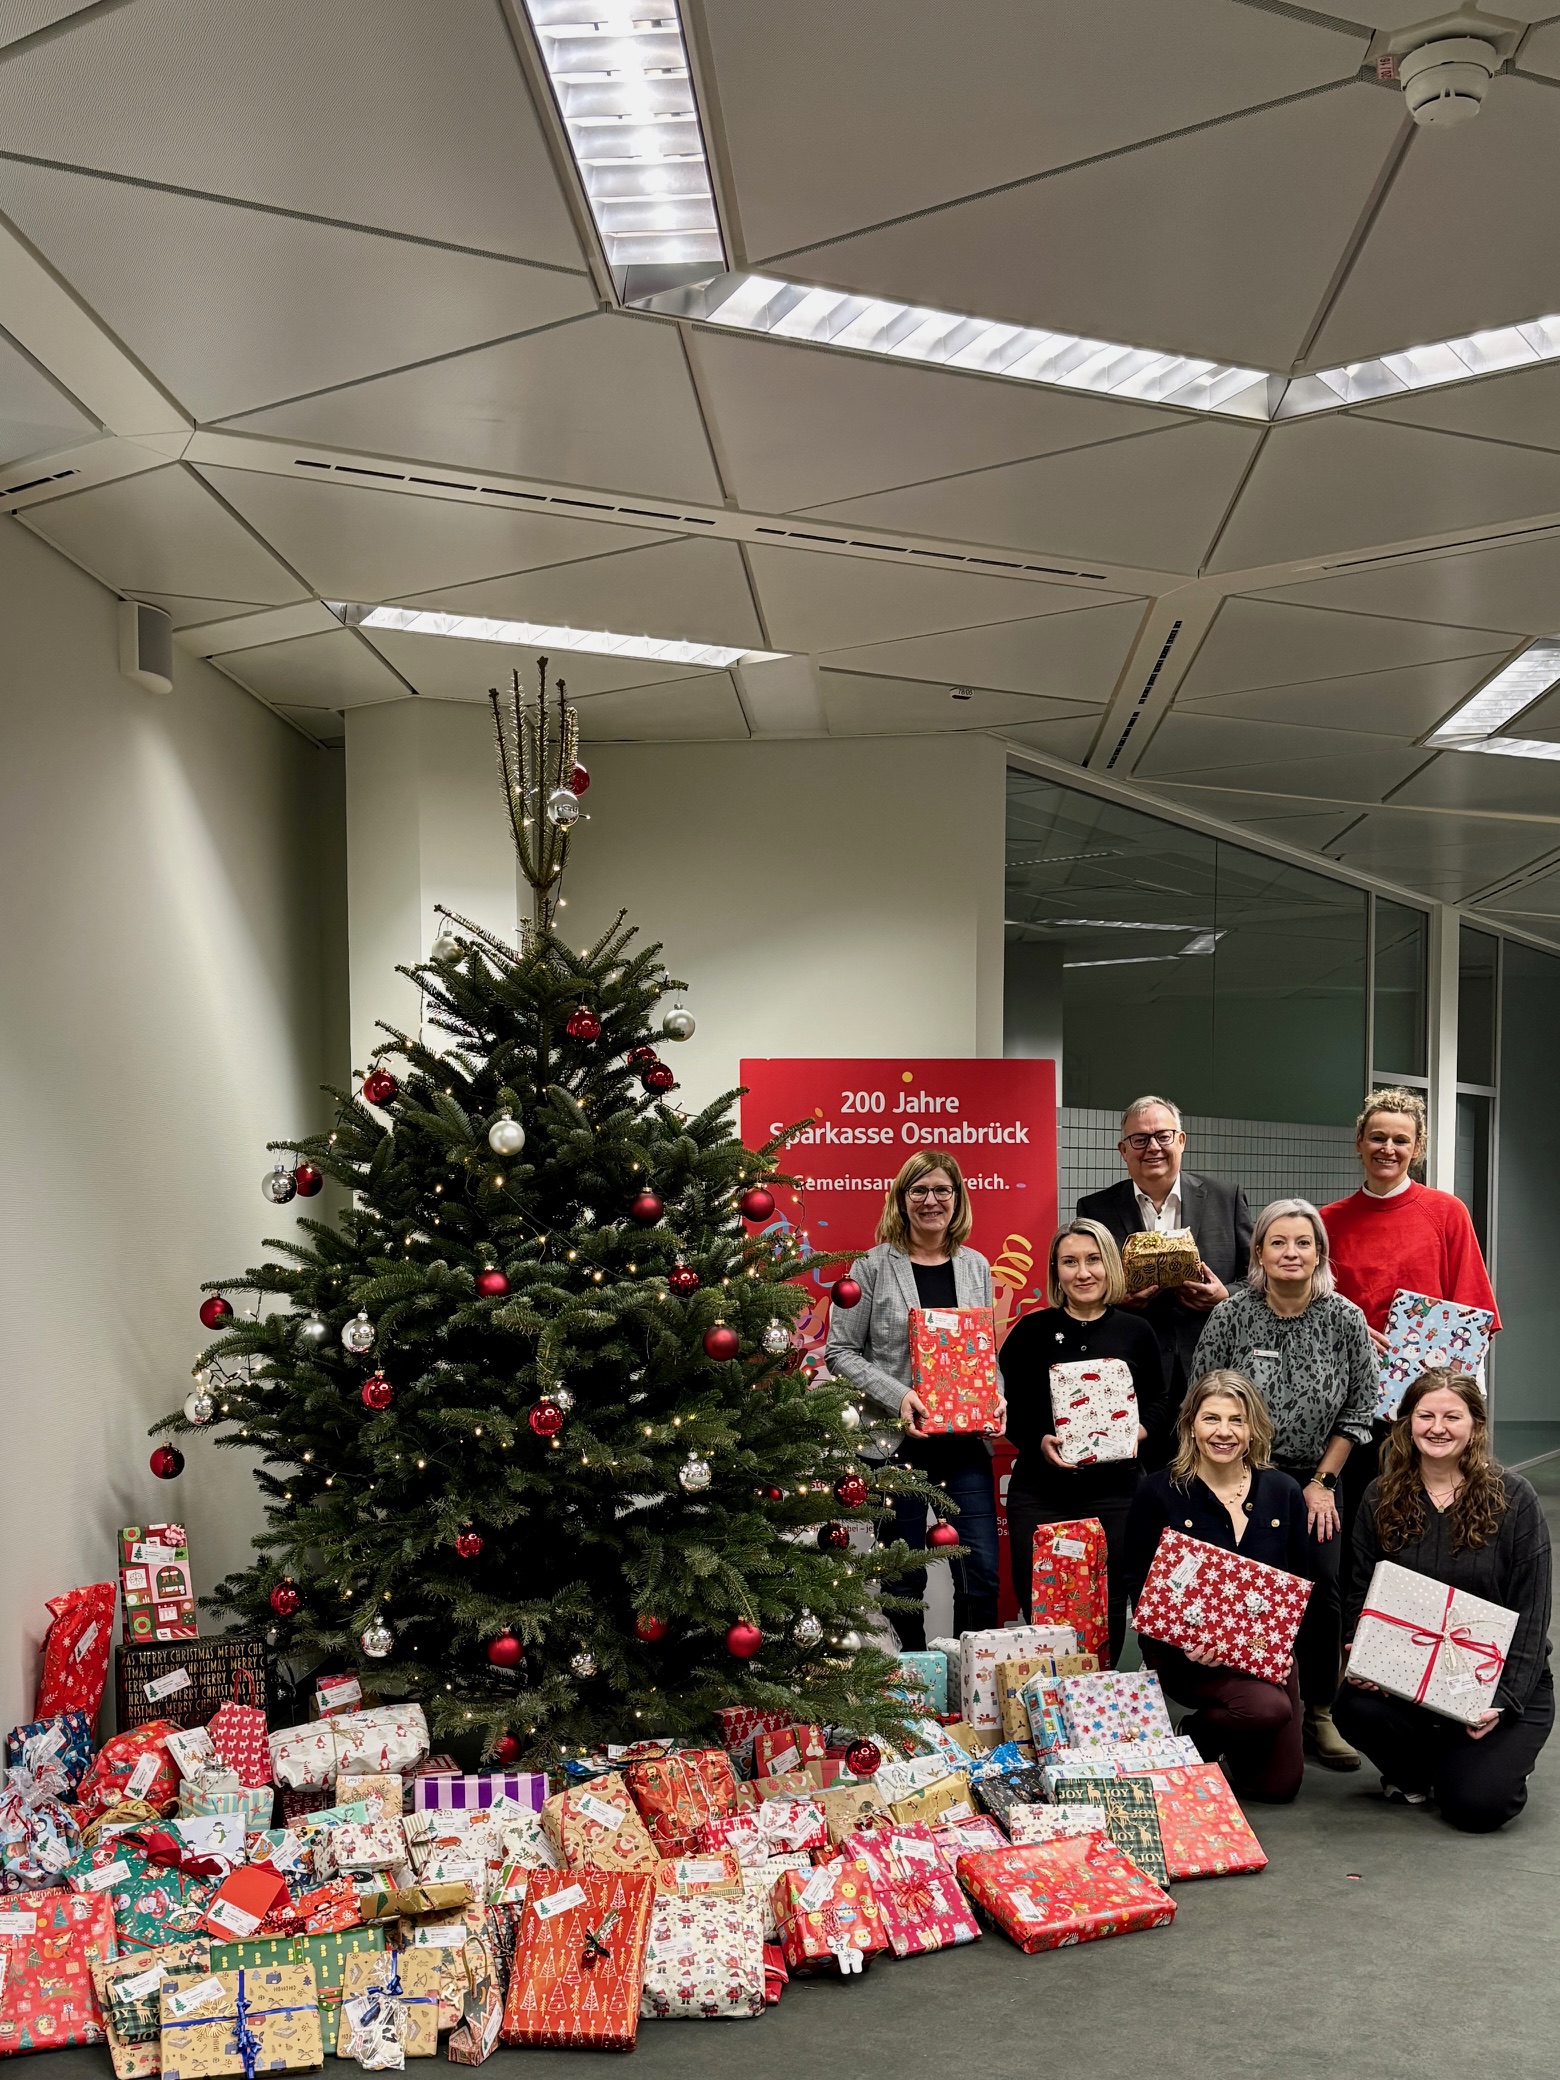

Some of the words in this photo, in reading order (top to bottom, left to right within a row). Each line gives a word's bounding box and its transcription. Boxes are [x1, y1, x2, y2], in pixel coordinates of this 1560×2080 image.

[840, 1091, 885, 1114] 200
[892, 1091, 960, 1114] Jahre
[769, 1121, 893, 1150] Sparkasse
[901, 1121, 1030, 1144] Osnabrück
[139, 1651, 167, 1665] MERRY
[170, 1647, 214, 1662] CHRISTMAS
[217, 1644, 245, 1658] MERRY
[230, 1656, 258, 1670] MERRY
[200, 1671, 227, 1685] MERRY
[128, 1703, 161, 1717] RISTMAS
[1059, 1789, 1084, 1799] JOY
[1138, 1853, 1164, 1863] JOY
